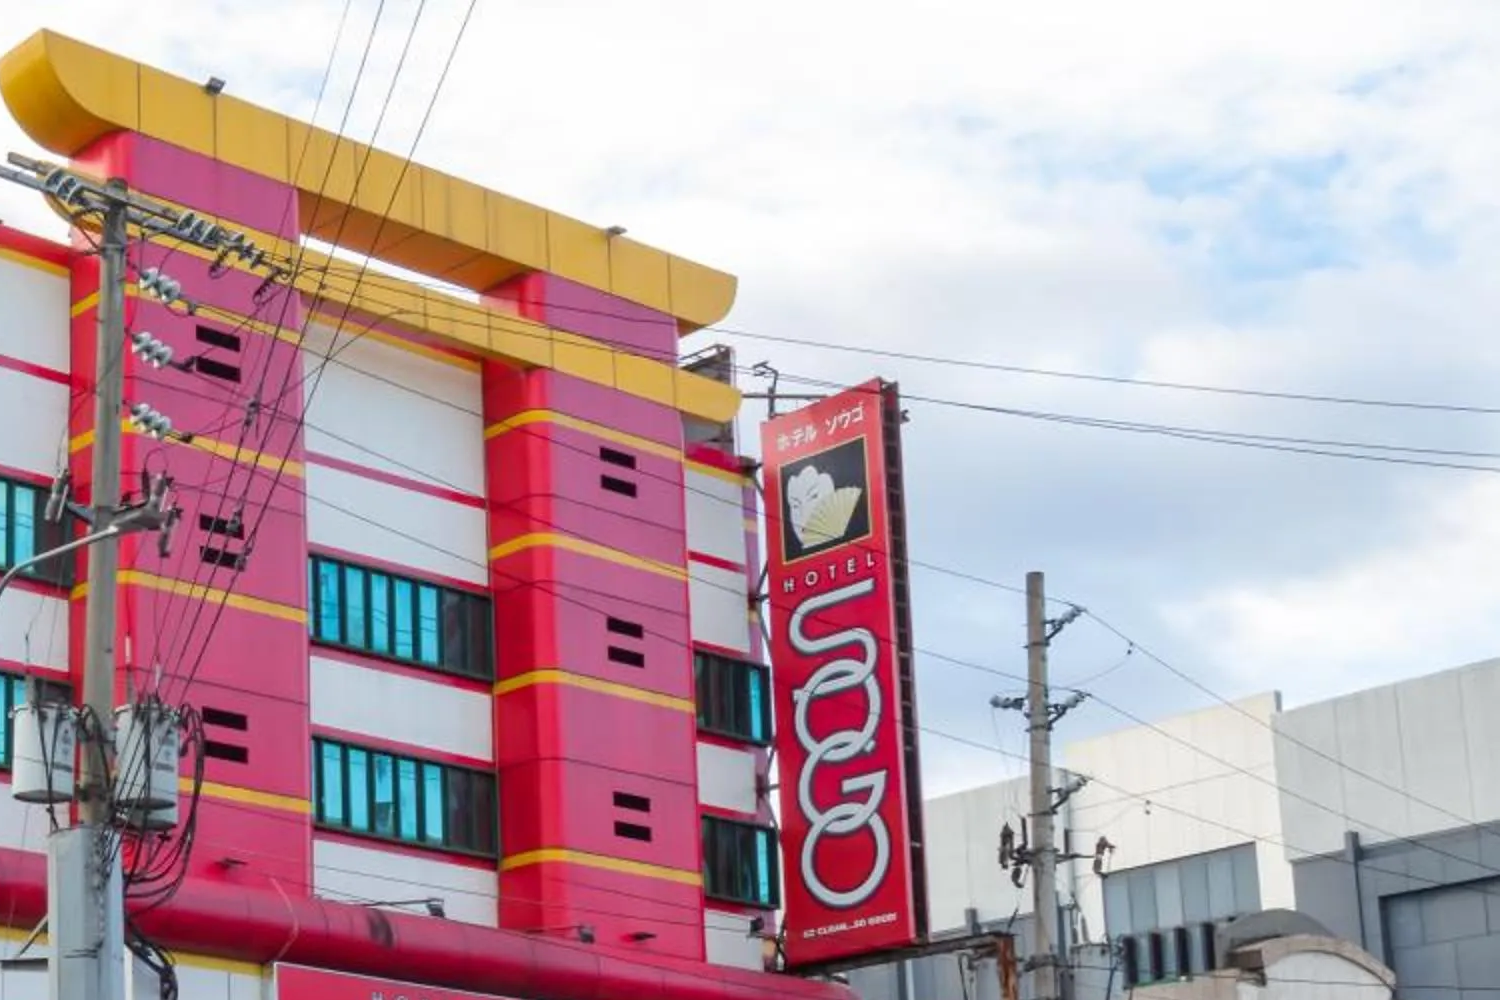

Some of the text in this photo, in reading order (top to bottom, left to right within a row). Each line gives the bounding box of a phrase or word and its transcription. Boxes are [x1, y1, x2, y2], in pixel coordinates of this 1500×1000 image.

[776, 402, 865, 450] ホテル ソウゴ
[784, 552, 876, 593] HOTEL
[789, 577, 892, 909] SOGO
